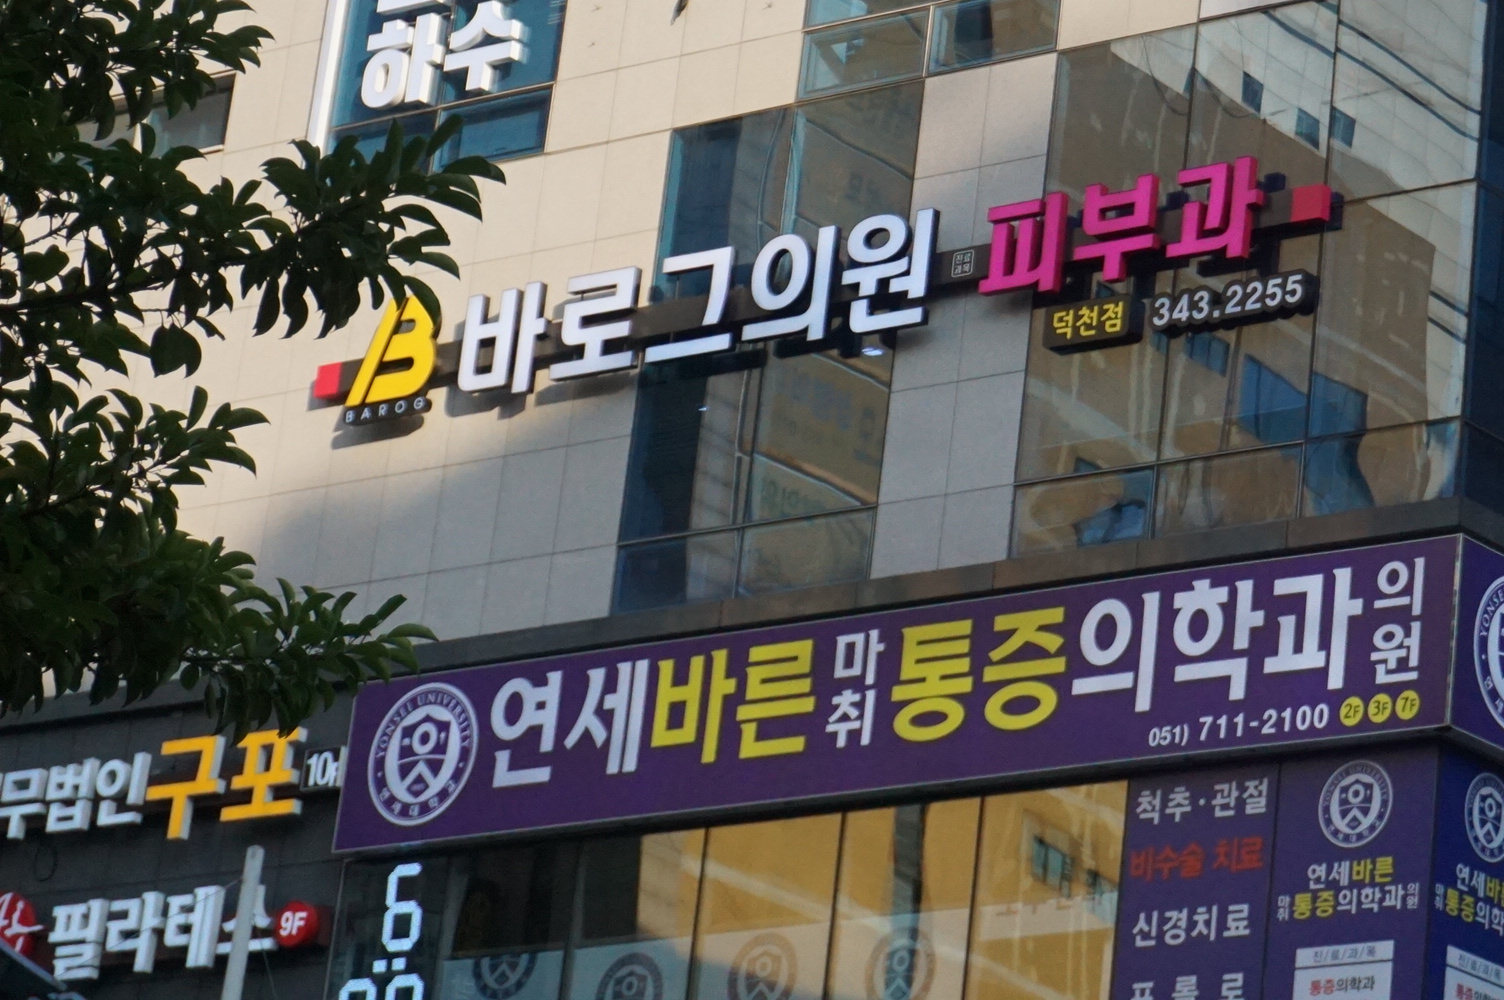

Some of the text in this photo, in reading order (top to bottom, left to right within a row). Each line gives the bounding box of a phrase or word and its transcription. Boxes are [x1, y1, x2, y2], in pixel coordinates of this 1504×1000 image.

[361, 0, 527, 110] 하수
[978, 156, 1266, 295] 피부과
[456, 207, 940, 395] 바로그의원
[1052, 300, 1124, 340] 덕천점
[1152, 273, 1303, 327] 343.2255
[345, 396, 425, 423] BAROG
[1148, 702, 1330, 748] 051) 711-2100
[1342, 695, 1417, 721] 2F 3F 7F
[0, 726, 306, 841] 무법인 구포
[1129, 835, 1266, 883] 비수술 치료
[48, 884, 278, 982] 필라테스
[279, 910, 308, 937] 9F
[1131, 902, 1251, 948] 신경치료
